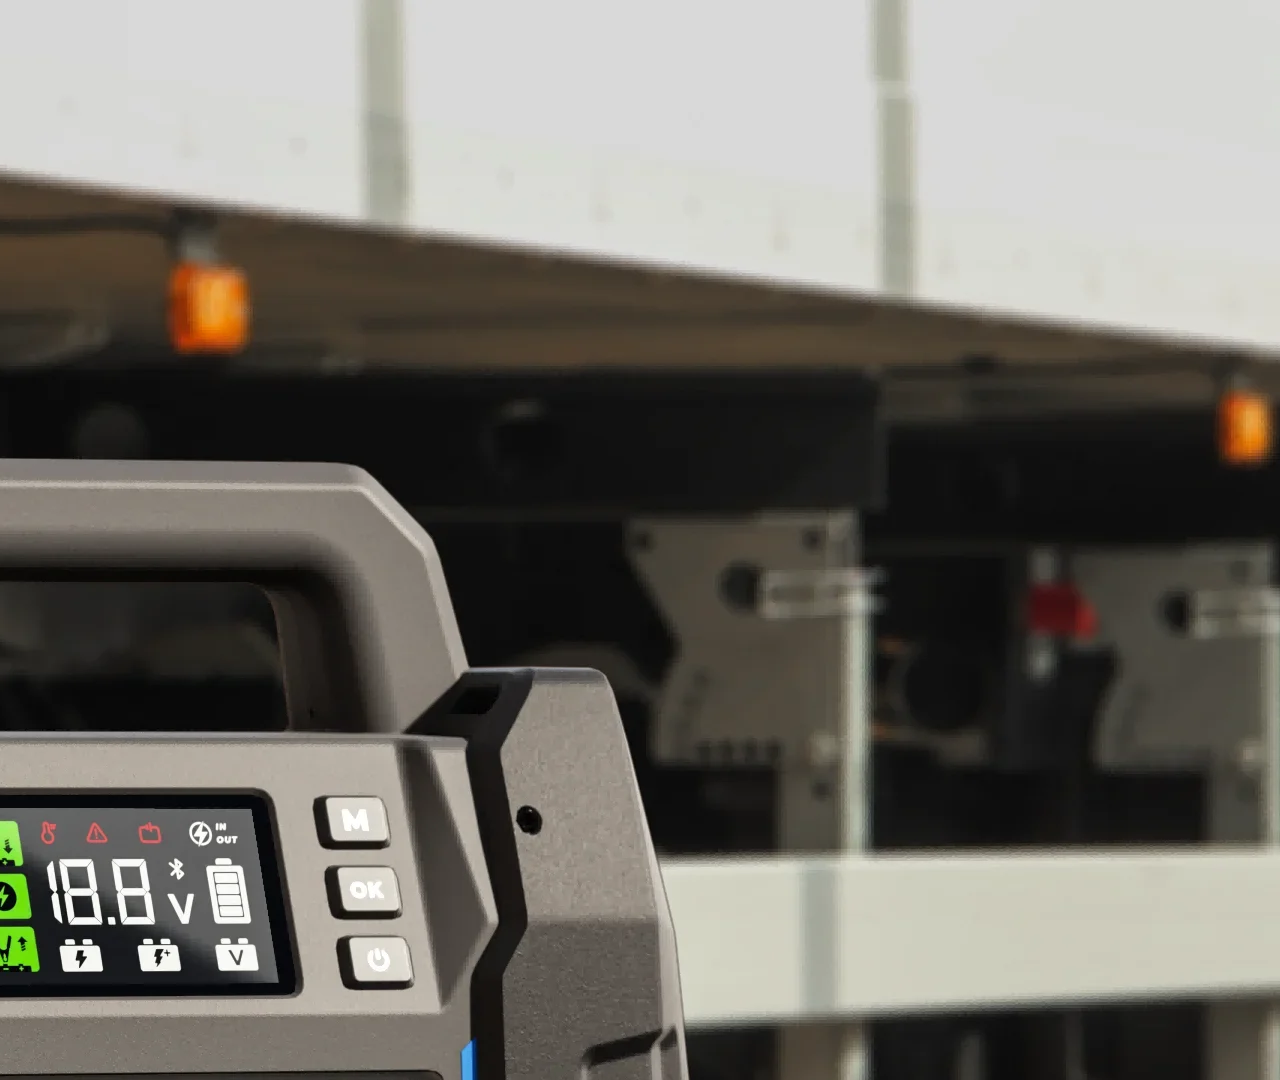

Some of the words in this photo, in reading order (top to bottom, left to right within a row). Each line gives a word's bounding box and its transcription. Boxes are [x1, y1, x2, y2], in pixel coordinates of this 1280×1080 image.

[215, 822, 227, 831] IN
[341, 808, 370, 832] M
[216, 835, 239, 845] OUT
[349, 880, 384, 899] OK
[167, 893, 195, 925] V
